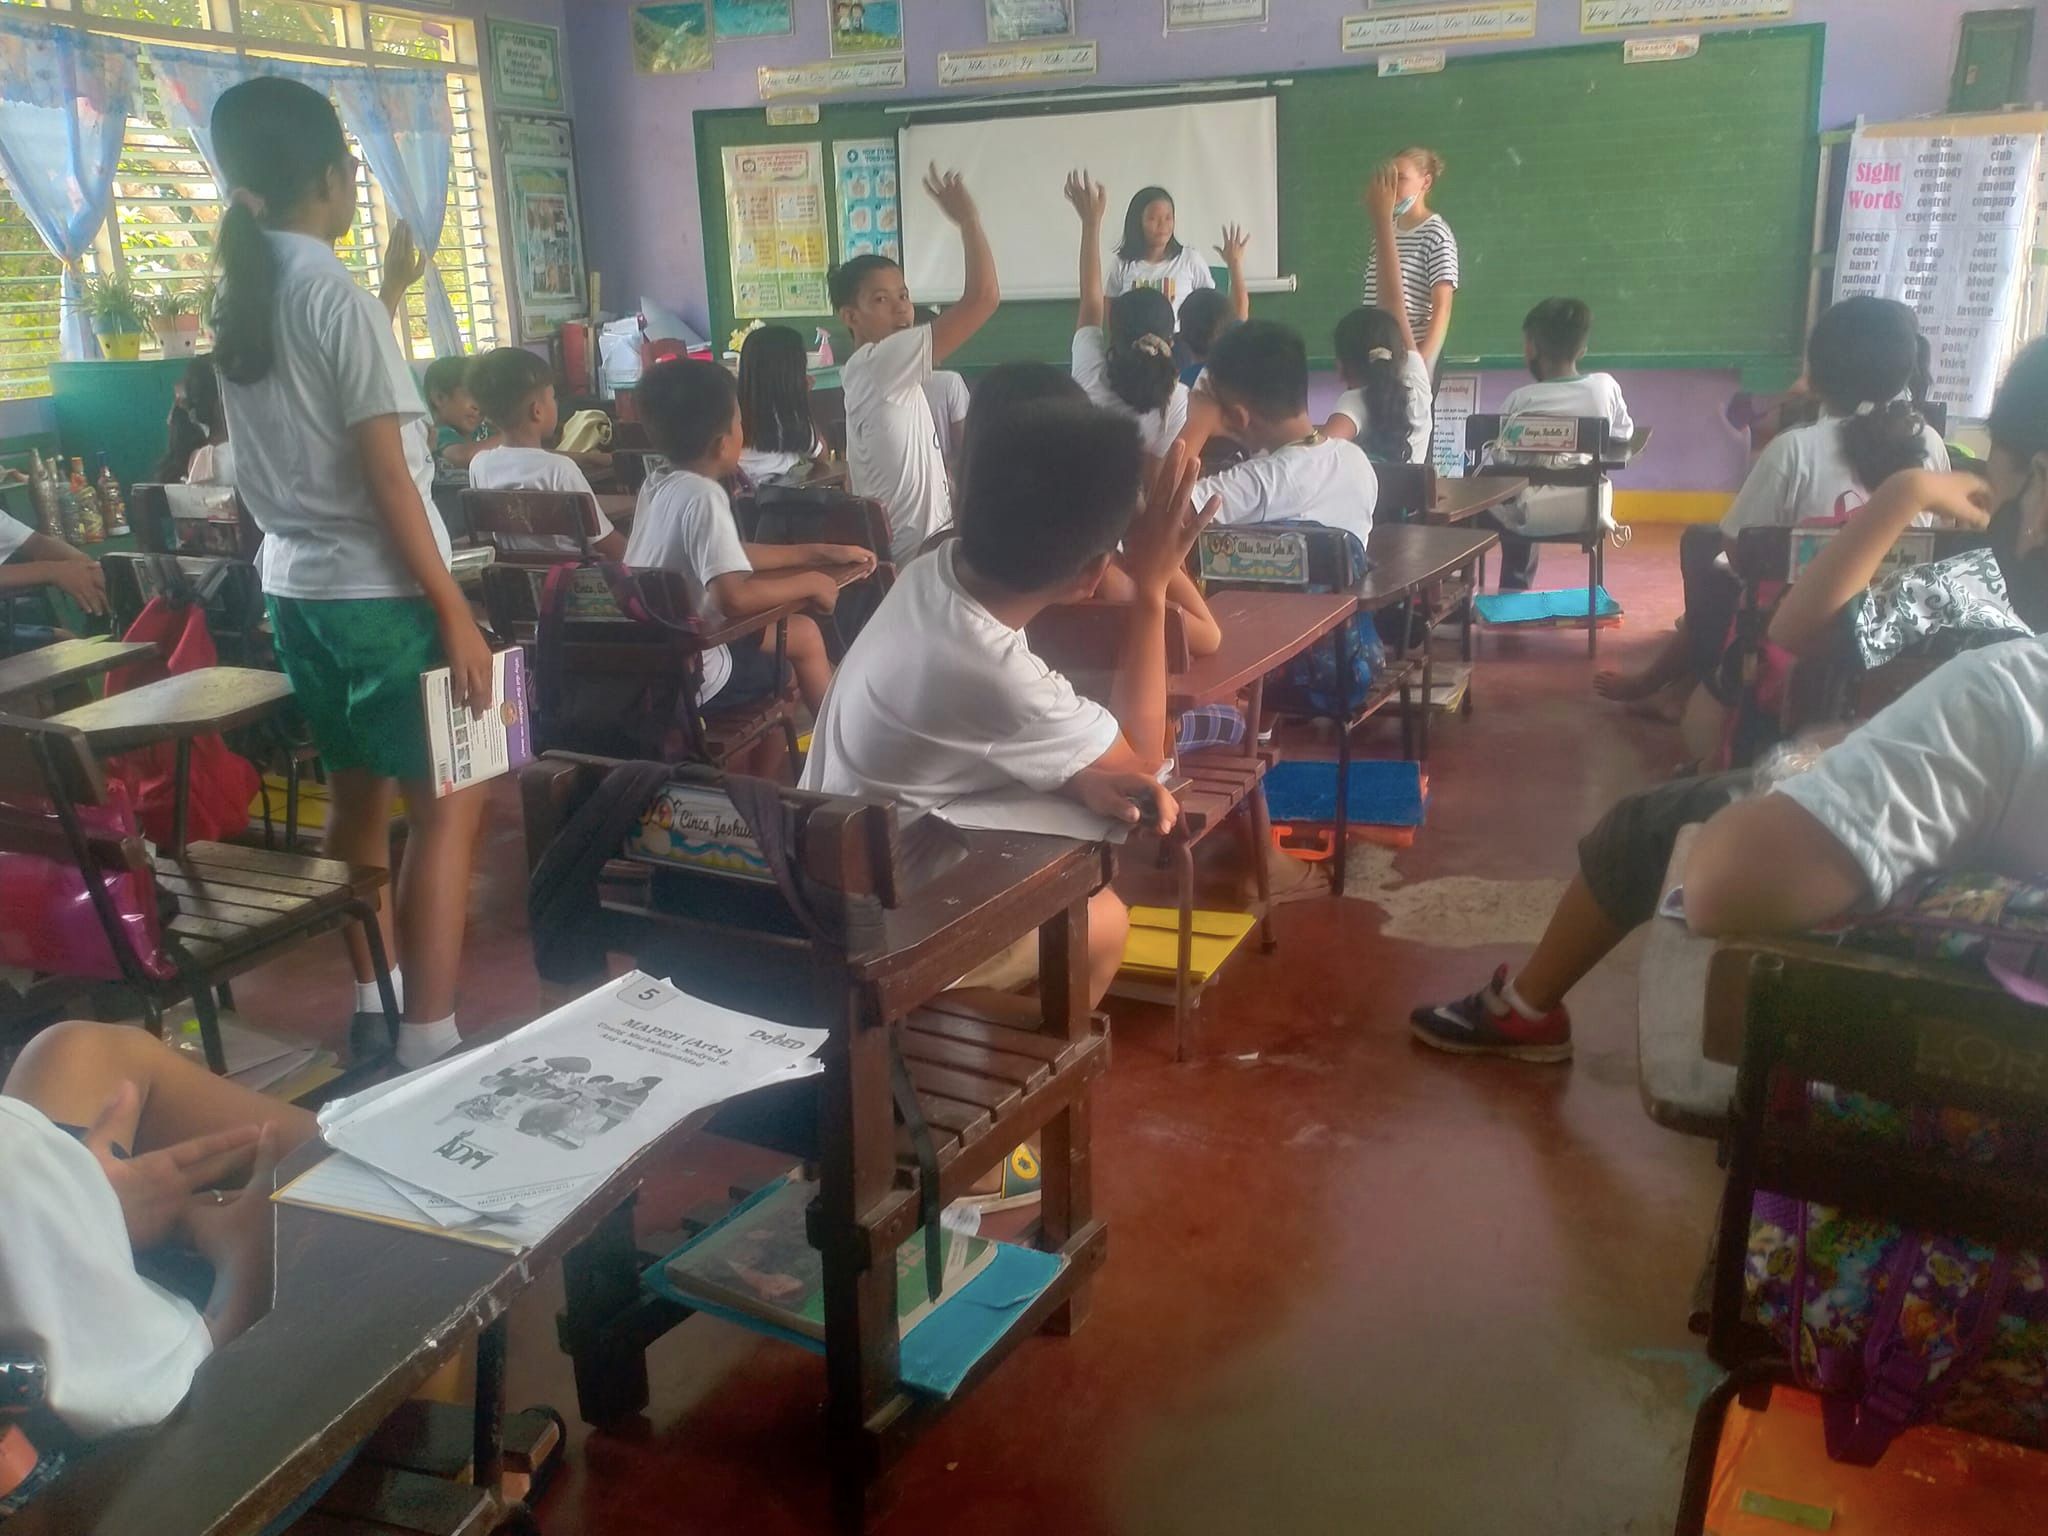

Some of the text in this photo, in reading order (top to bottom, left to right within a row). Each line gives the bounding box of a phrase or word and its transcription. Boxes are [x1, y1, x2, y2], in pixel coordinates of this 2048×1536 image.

[1931, 137, 1953, 149] area
[1992, 134, 2017, 146] alive
[1918, 153, 1962, 163] condition
[1990, 150, 2012, 161] club
[1855, 162, 1902, 184] Sight
[1914, 167, 1963, 178] everybody
[1983, 166, 2015, 176] eleven
[1920, 181, 1952, 192] awhile
[1977, 181, 2016, 192] amount
[1848, 190, 1904, 209] Words
[1917, 196, 1951, 207] control
[1972, 196, 2016, 208] company
[1905, 211, 1957, 223] experience
[1848, 231, 1889, 242] molecule
[1852, 247, 1879, 257] cause
[1907, 247, 1944, 259] develop
[1849, 260, 1878, 271] hasn't
[1842, 274, 1881, 285] national
[1904, 275, 1938, 286] central
[1905, 289, 1932, 300] direct
[638, 988, 660, 1000] 5
[623, 1018, 733, 1057] MAPEH (Arts)
[433, 1132, 494, 1170] ADM
